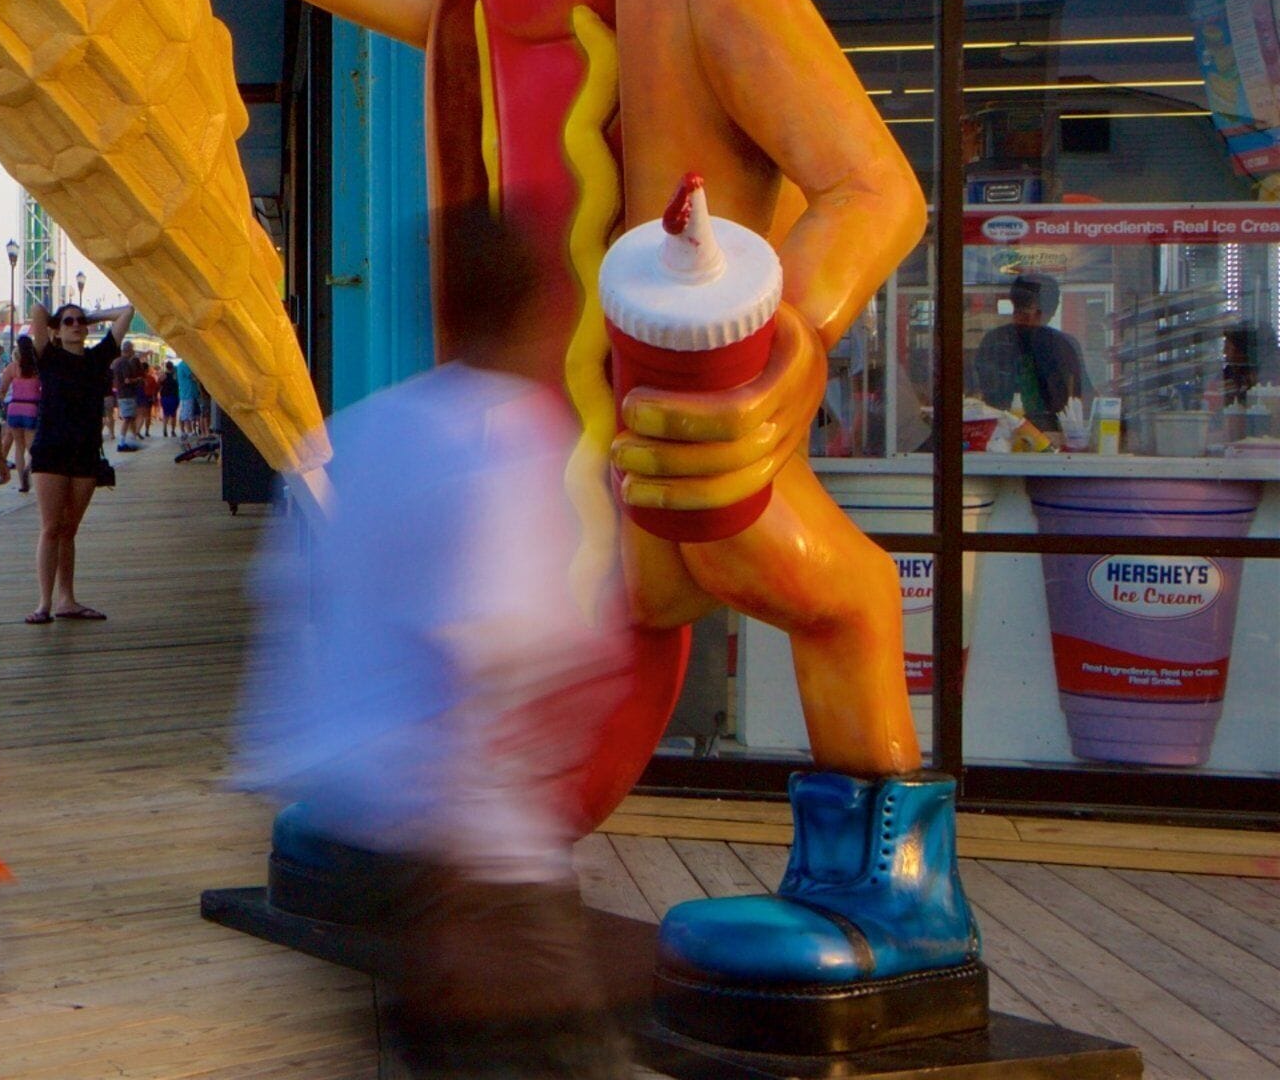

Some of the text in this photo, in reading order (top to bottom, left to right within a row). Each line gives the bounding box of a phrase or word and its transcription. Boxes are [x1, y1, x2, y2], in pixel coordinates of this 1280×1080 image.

[1036, 221, 1069, 234] Real
[1074, 221, 1168, 237] Ingredients.
[1173, 221, 1207, 234] Real
[1213, 220, 1236, 233] Ice
[1107, 562, 1209, 584] HERSHEY'S
[1113, 584, 1205, 605] Ice Cream
[1082, 663, 1102, 672] Real
[1160, 668, 1181, 677] Real
[1181, 669, 1194, 677] Ice
[1129, 676, 1150, 685] Real
